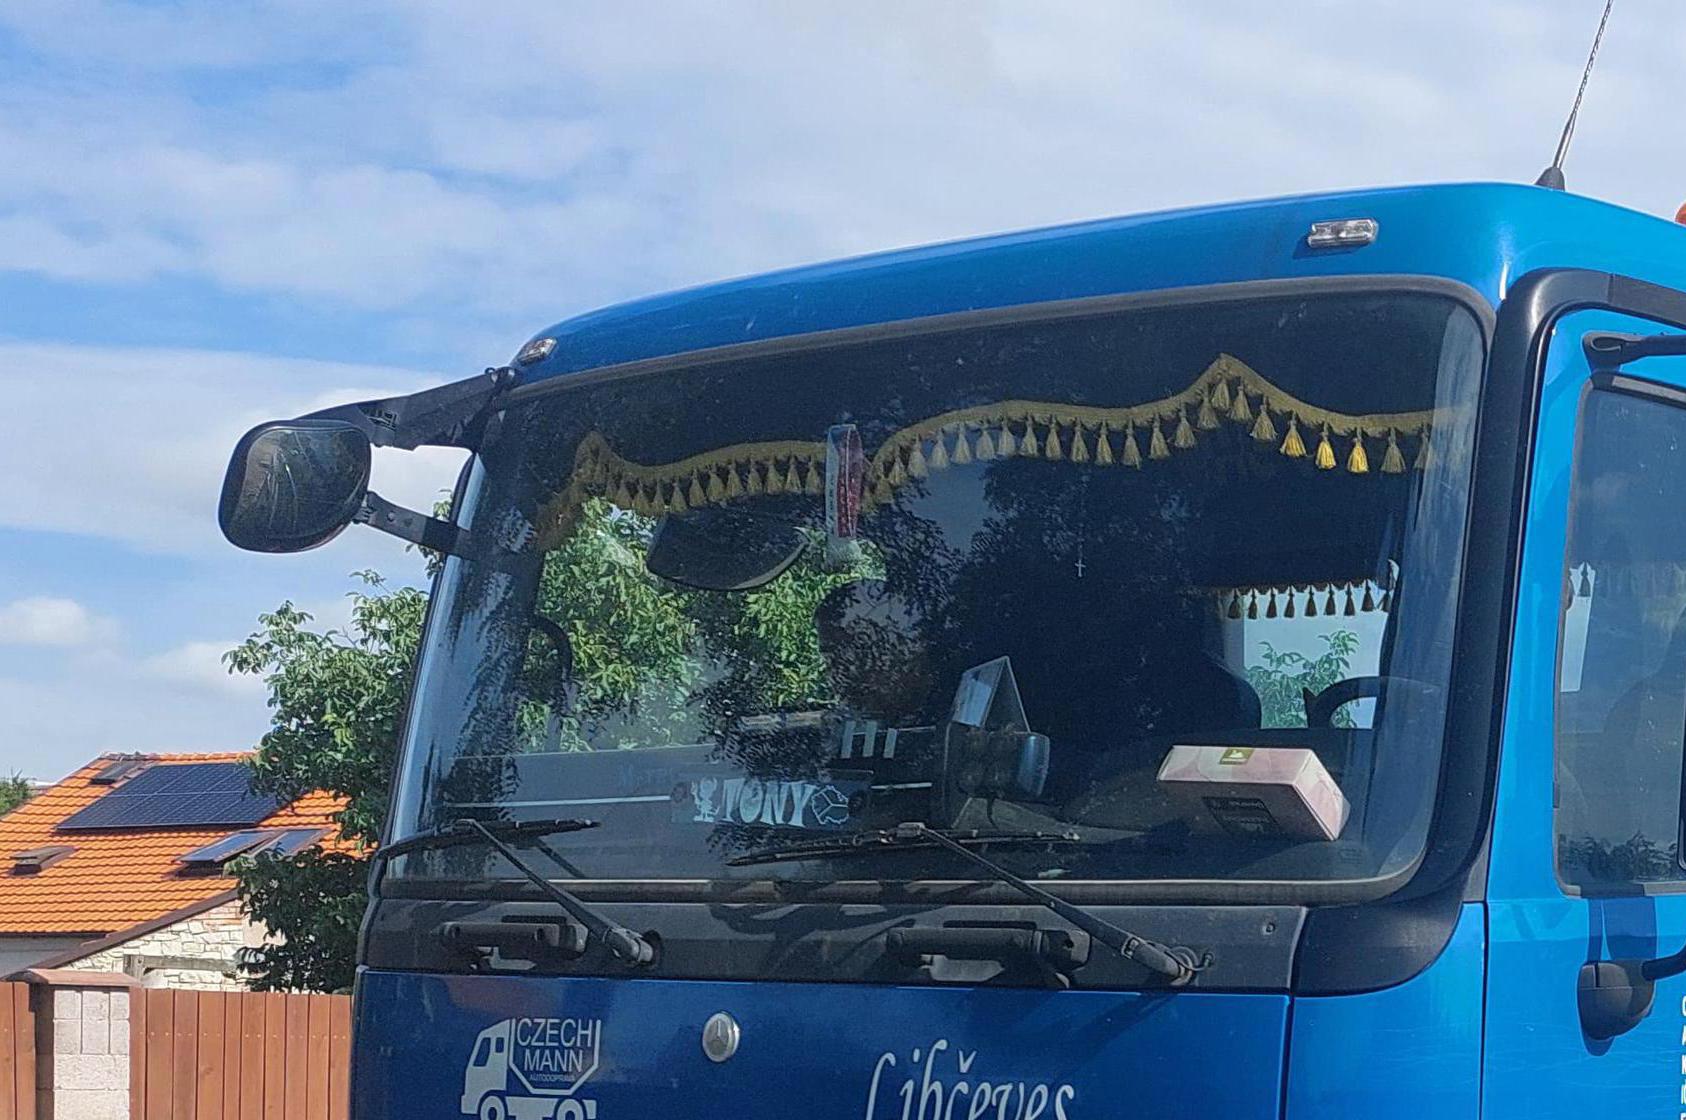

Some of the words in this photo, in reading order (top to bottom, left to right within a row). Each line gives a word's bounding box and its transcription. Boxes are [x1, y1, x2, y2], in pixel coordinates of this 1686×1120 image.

[722, 778, 819, 828] TONY
[516, 1017, 593, 1047] CZECH
[523, 1048, 584, 1073] MANN
